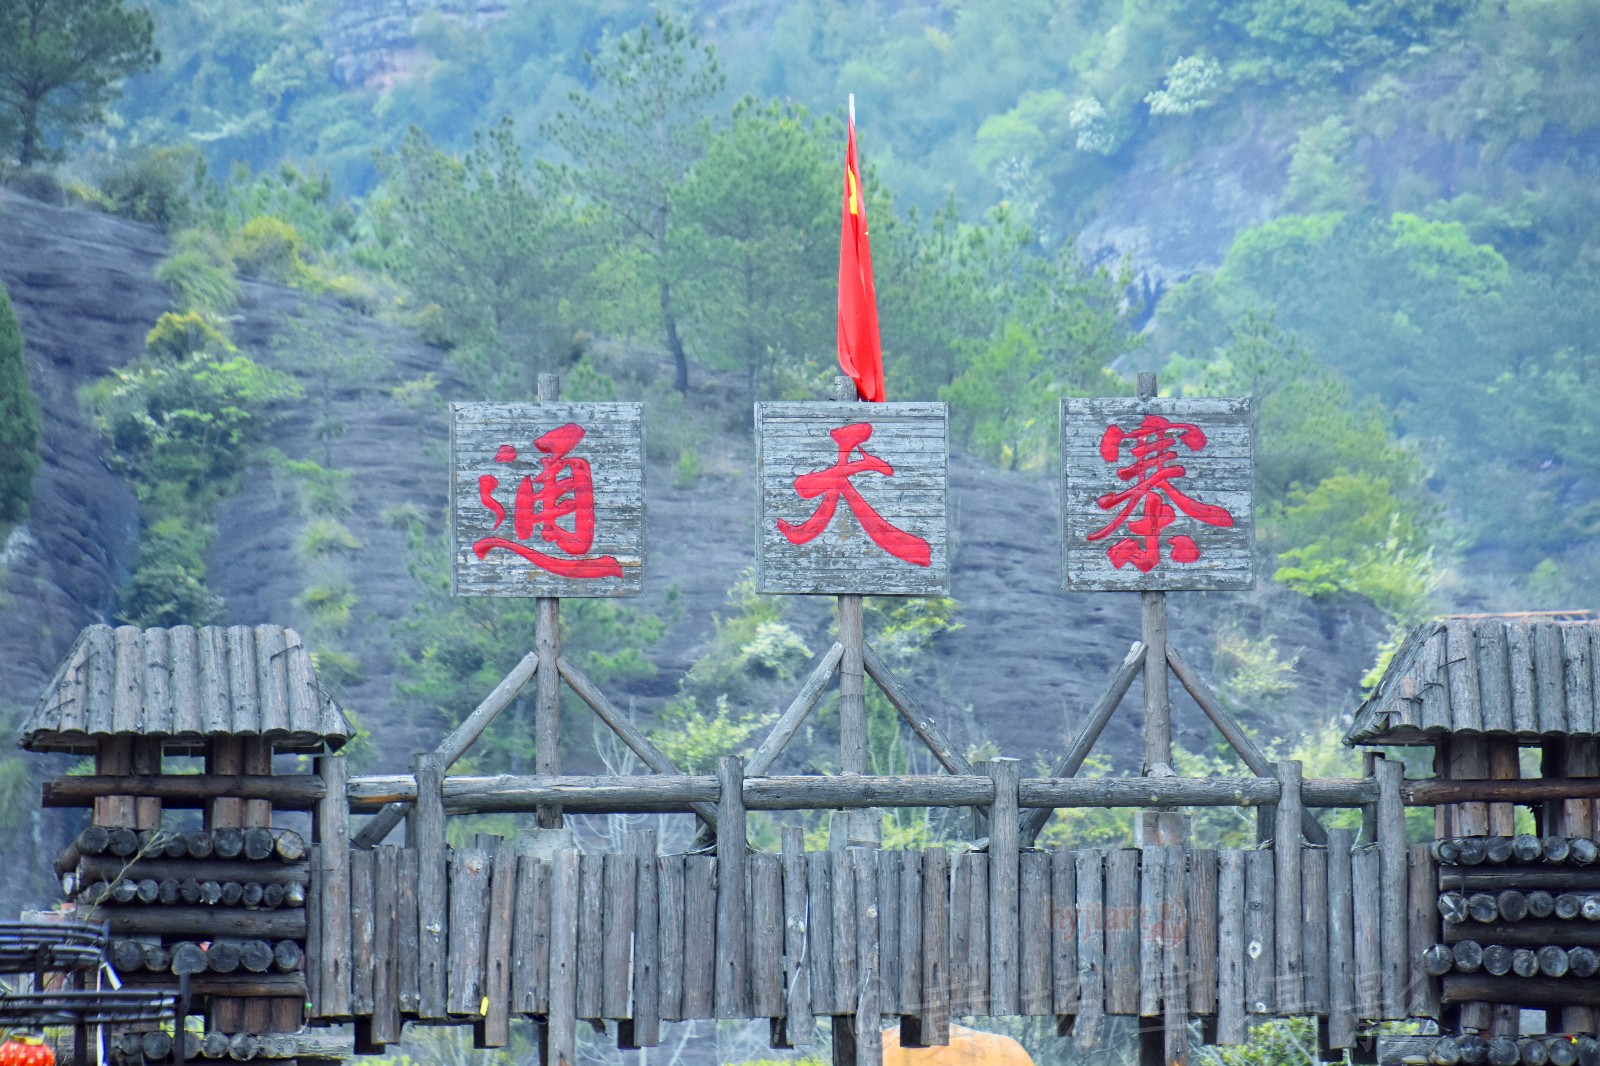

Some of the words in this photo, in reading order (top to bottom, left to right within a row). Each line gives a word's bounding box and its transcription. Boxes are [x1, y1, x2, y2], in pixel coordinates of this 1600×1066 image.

[472, 423, 624, 579] 通
[777, 422, 931, 567] 天
[1088, 415, 1234, 573] 寨
